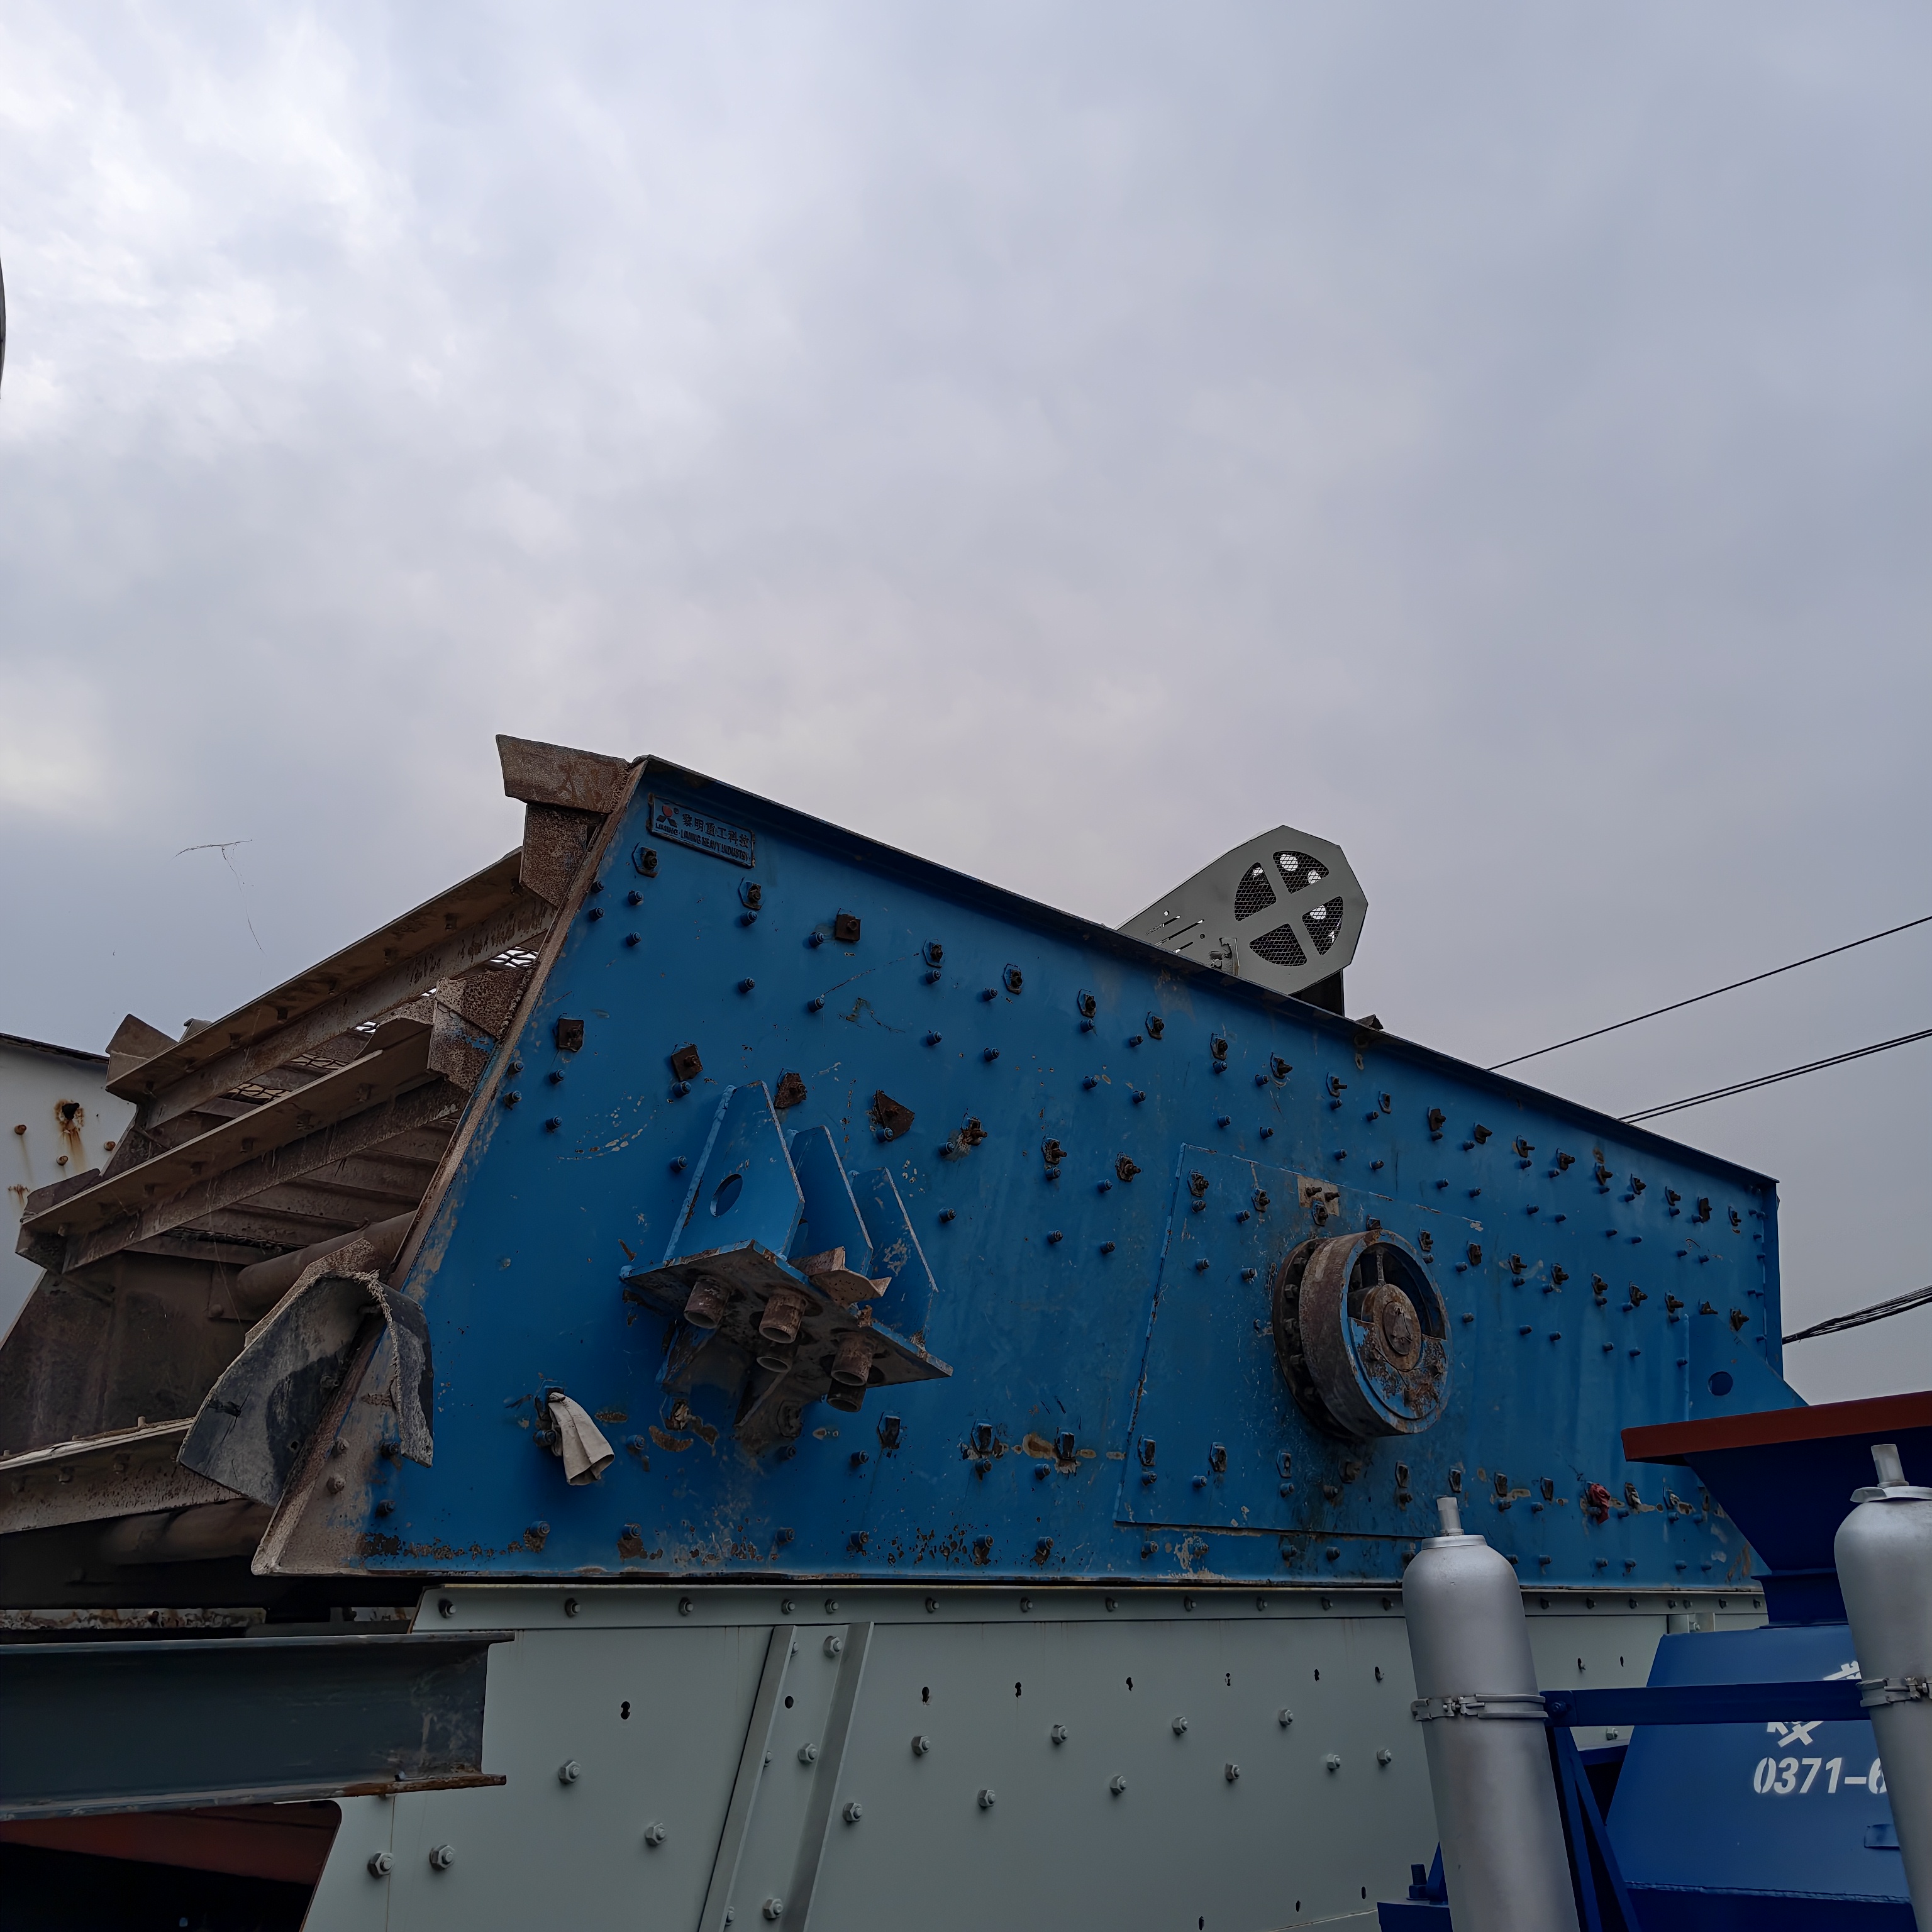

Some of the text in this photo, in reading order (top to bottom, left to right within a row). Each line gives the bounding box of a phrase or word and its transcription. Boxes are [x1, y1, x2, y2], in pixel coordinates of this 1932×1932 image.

[680, 828, 750, 862] LIMING HEAVY INDUSTRY
[682, 813, 750, 848] 黎明重工科技
